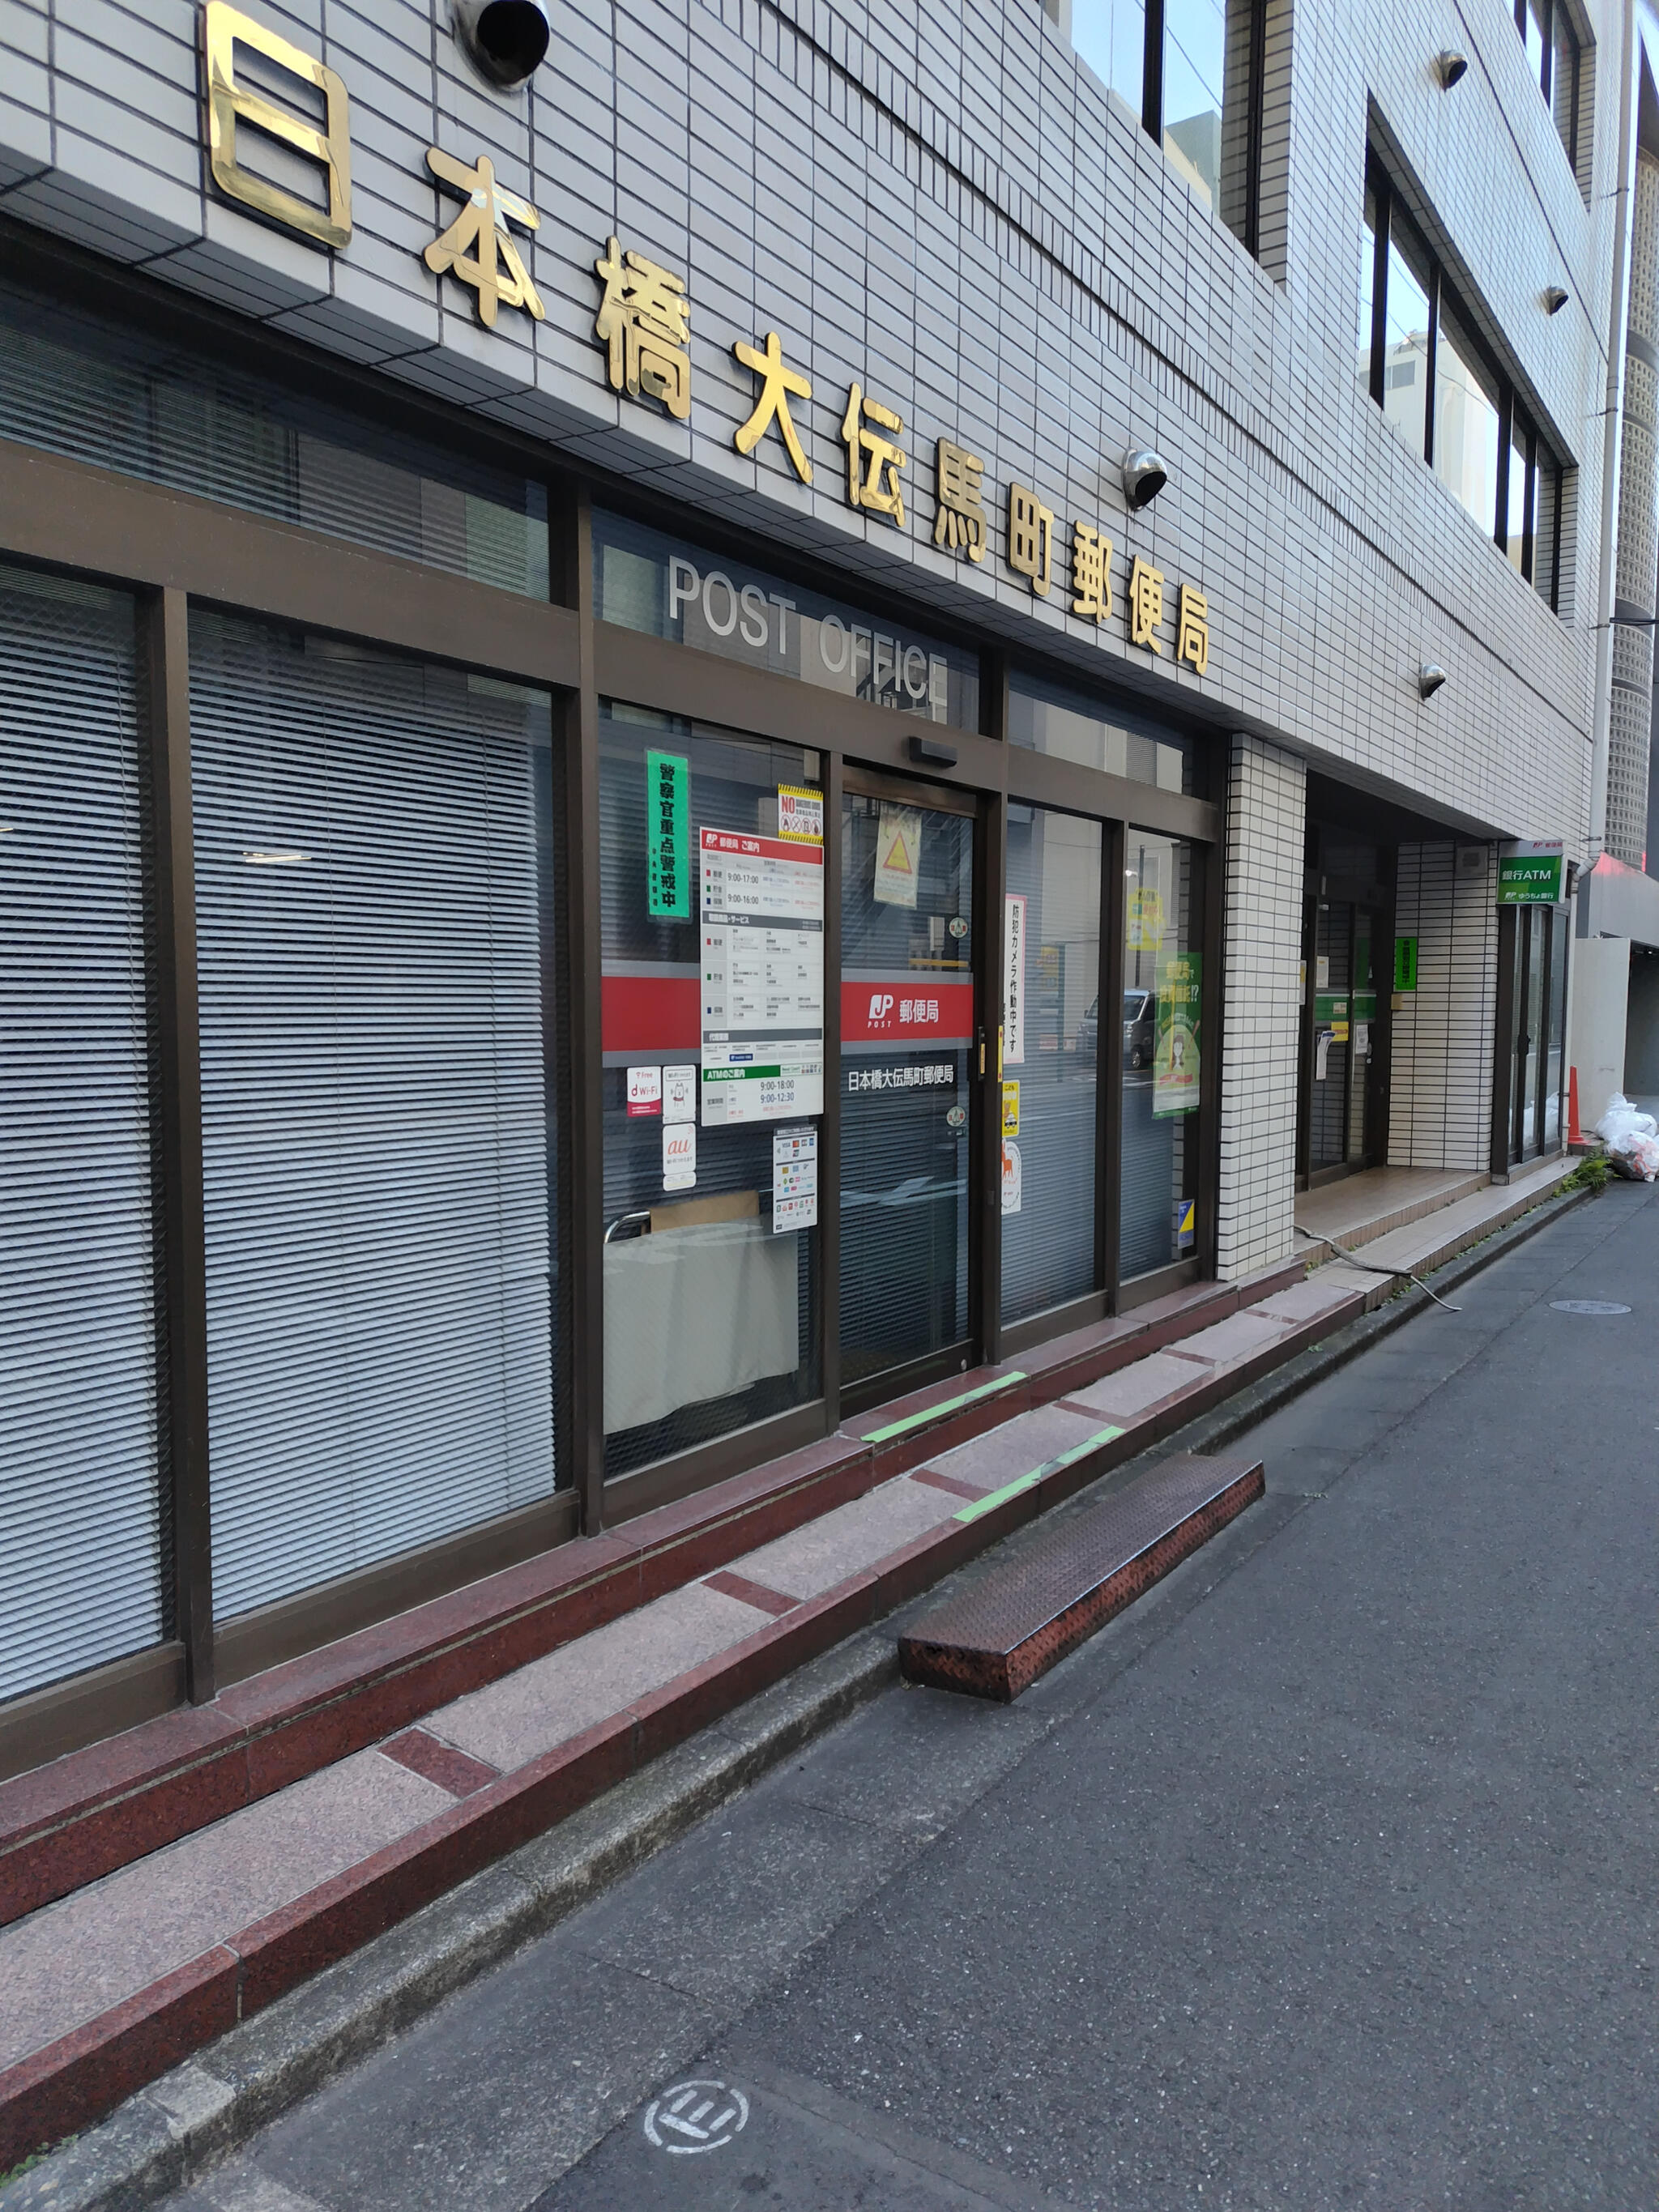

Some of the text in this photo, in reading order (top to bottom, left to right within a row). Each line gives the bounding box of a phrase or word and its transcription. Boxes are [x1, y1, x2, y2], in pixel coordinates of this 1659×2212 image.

[206, 0, 1209, 676] 日本橋大伝馬町郵便局
[668, 555, 948, 706] POST OFFICE
[781, 795, 795, 814] NO
[659, 763, 676, 908] 警察官重点警戒中
[741, 840, 761, 853] ご案内
[727, 872, 759, 884] 9:00-17:00
[1502, 870, 1551, 880] 銀行ATM
[727, 893, 759, 905] 9:00-16:00
[1009, 904, 1020, 1052] 防犯カメラ作動中です
[899, 999, 939, 1024] 郵便局
[867, 1020, 892, 1029] POST
[761, 1080, 795, 1091] 9:00-18:00
[848, 1064, 954, 1092] 日本橋大伝馬町郵便局
[639, 1085, 658, 1096] Wi-Fi
[761, 1092, 795, 1103] 9:00-12:30
[667, 1139, 693, 1156] au
